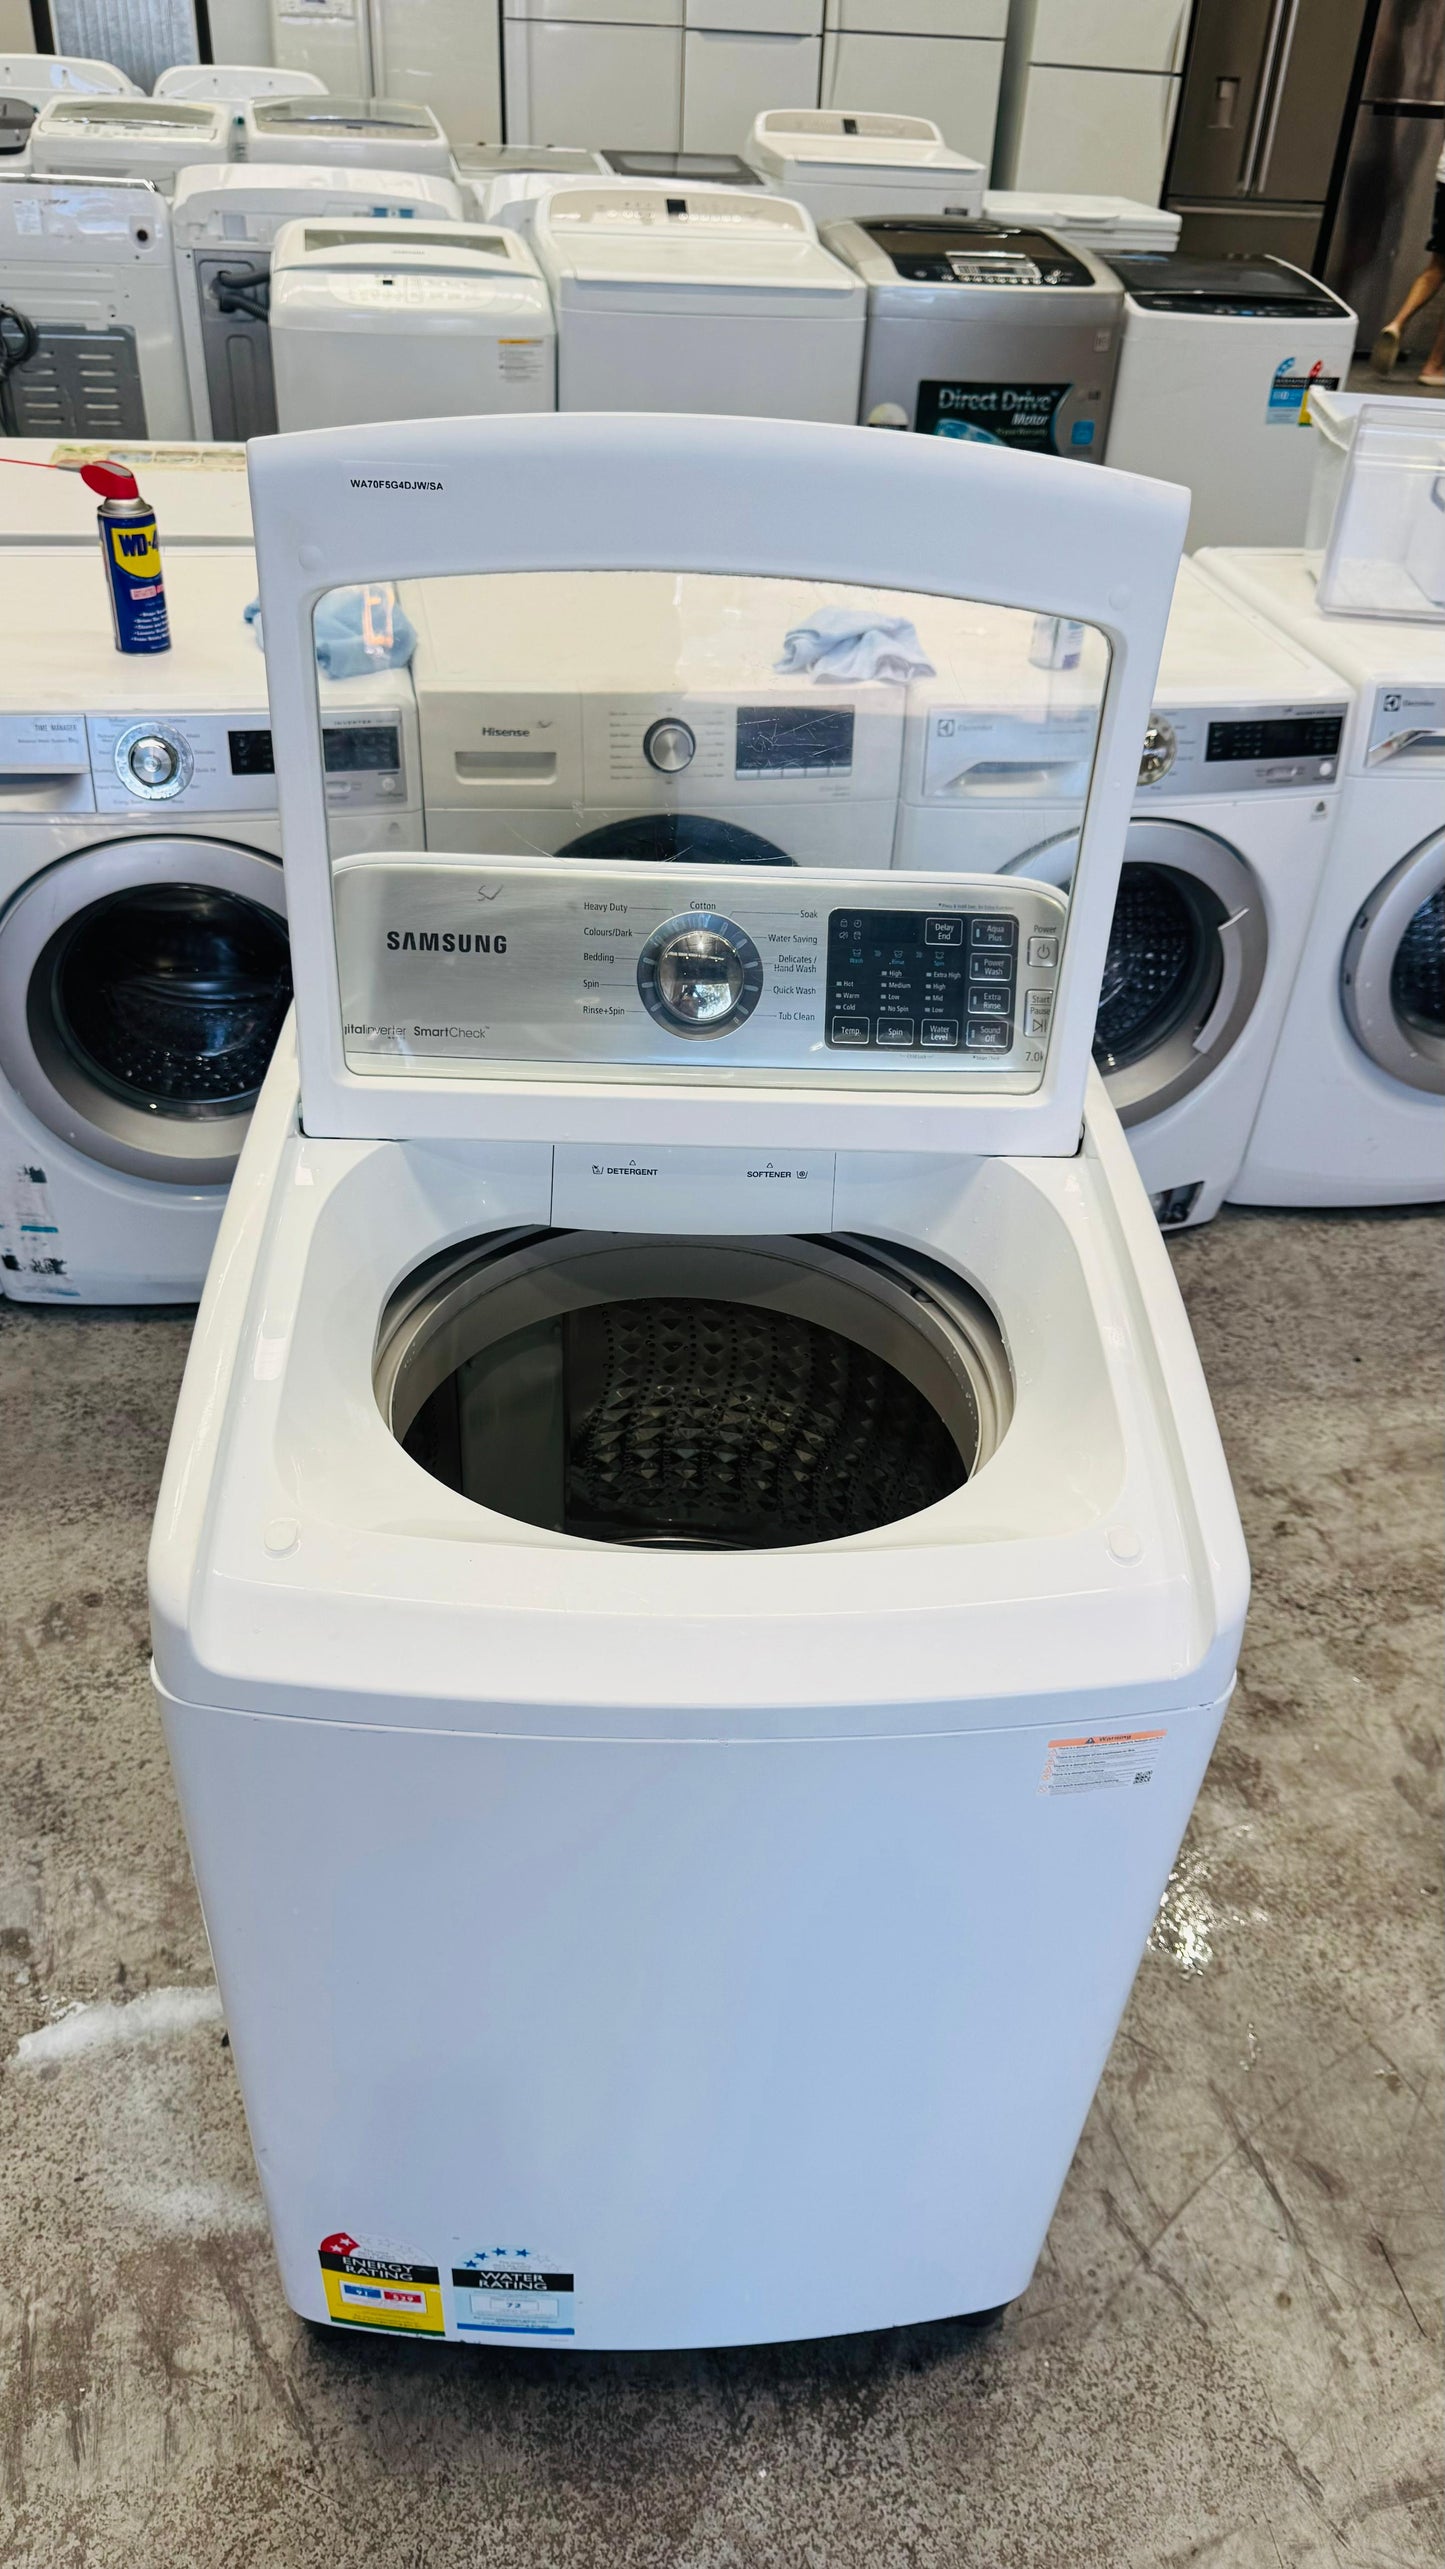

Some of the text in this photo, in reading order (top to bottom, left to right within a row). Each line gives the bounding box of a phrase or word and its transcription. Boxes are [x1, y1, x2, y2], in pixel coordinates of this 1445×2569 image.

[938, 389, 1050, 410] Direct Drive
[350, 479, 444, 491] WA70F5G4DJW/SA
[482, 727, 530, 737] Hisense
[583, 902, 628, 913] Heavy Duty
[689, 901, 716, 910] Cotton
[800, 909, 818, 919] Soak
[935, 922, 954, 932] Delay
[986, 924, 1005, 935] Aqua
[1034, 924, 1057, 933] Power
[583, 927, 633, 938] Colours/Dark
[938, 932, 951, 941] End
[386, 930, 508, 954] SAMSUNG
[768, 934, 818, 945] Water Saving
[988, 934, 1003, 942] Plus
[583, 952, 615, 963] Bedding
[778, 955, 812, 964] Delicates
[774, 963, 817, 973] Hand Wash
[984, 958, 1005, 968] Power
[889, 970, 902, 978] High
[933, 970, 961, 980] Extra High
[985, 967, 1003, 976] Wash
[583, 979, 600, 990] Spin
[888, 982, 912, 990] Medium
[932, 983, 946, 991] High
[773, 985, 817, 995] Quick Wash
[983, 993, 1001, 1002] Extra
[1032, 994, 1051, 1004] Start
[582, 1005, 625, 1016] Rinse+Spin
[896, 1005, 909, 1013] Spin
[983, 1002, 1001, 1010] Rinse
[1030, 1006, 1051, 1016] Pause
[778, 1012, 816, 1021] Tub Clean
[841, 1026, 862, 1036] Temp.
[888, 1027, 903, 1038] Spin
[929, 1024, 950, 1033] Water
[979, 1026, 1001, 1034] Sound
[930, 1032, 949, 1041] Level
[984, 1034, 996, 1043] Off
[606, 1166, 659, 1176] DETERGENT
[746, 1170, 792, 1178] SOFTENER
[342, 2256, 414, 2273] ENERGY
[345, 2265, 414, 2282] RATING
[480, 2271, 545, 2283] WATER
[479, 2279, 548, 2291] RATING
